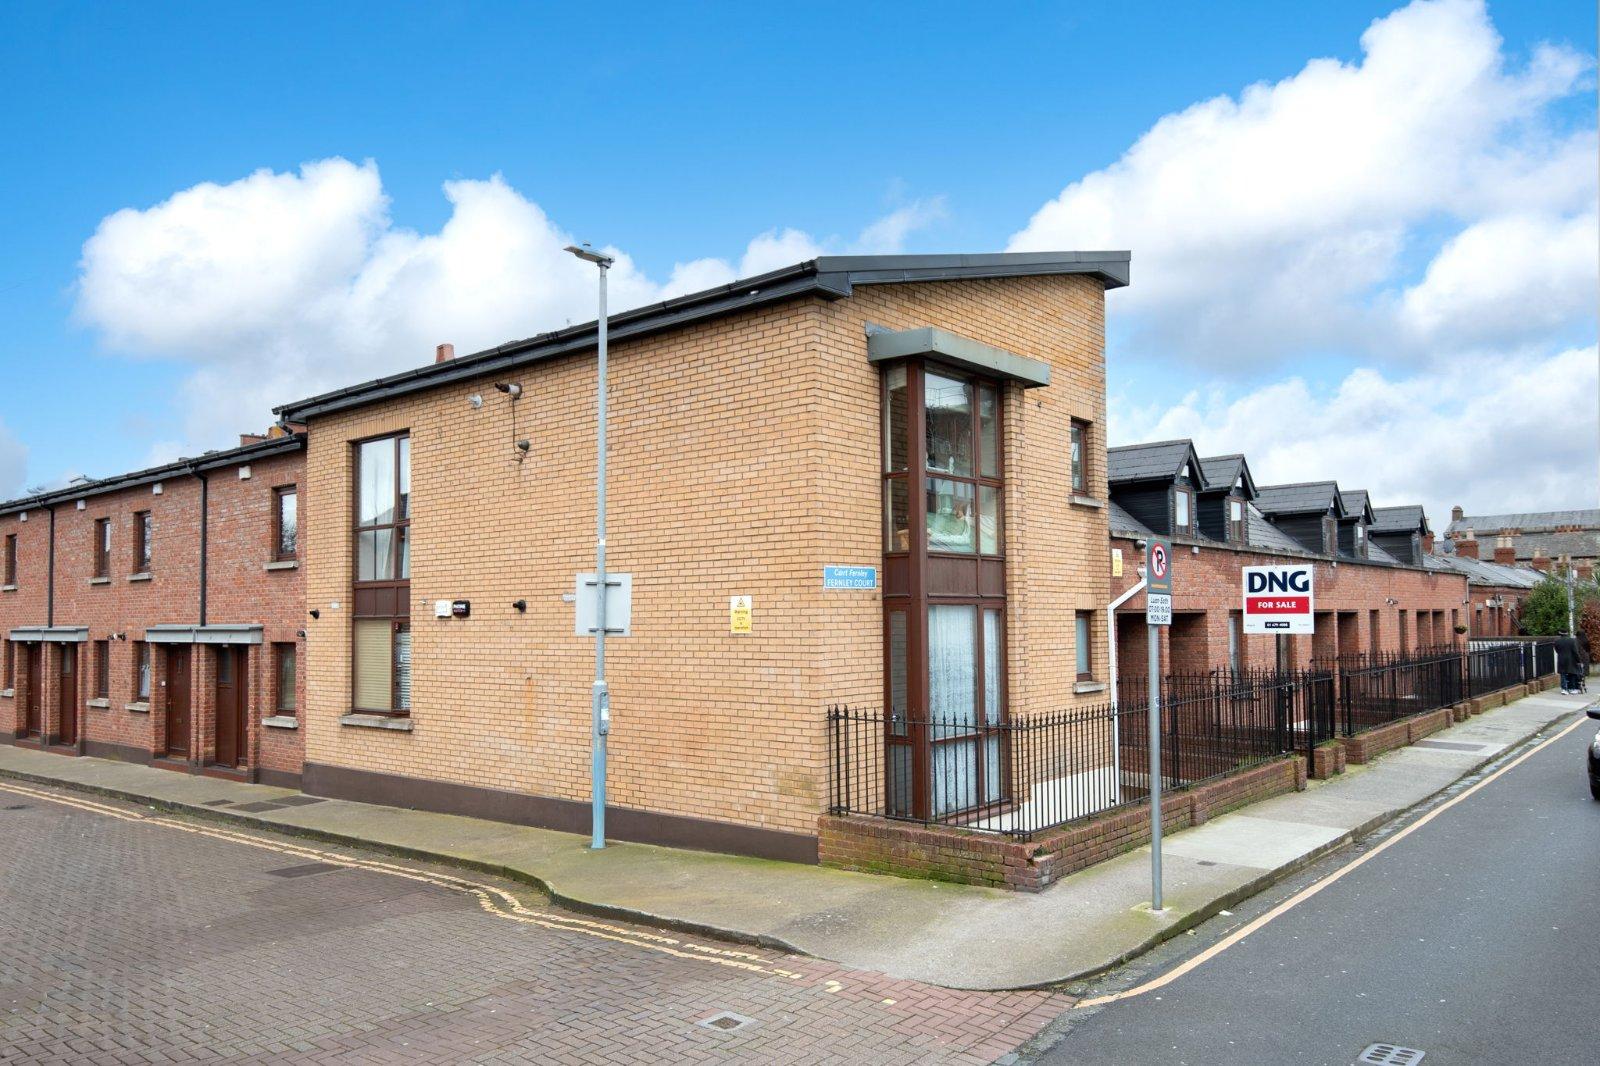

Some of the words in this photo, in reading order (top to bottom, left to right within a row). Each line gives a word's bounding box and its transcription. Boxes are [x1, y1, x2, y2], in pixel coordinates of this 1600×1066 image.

[849, 569, 867, 578] Fernley
[827, 578, 852, 587] FERNLEY
[854, 579, 874, 587] COURT
[1248, 571, 1310, 593] DNG
[1257, 601, 1274, 609] FOR
[1276, 601, 1297, 609] SALE
